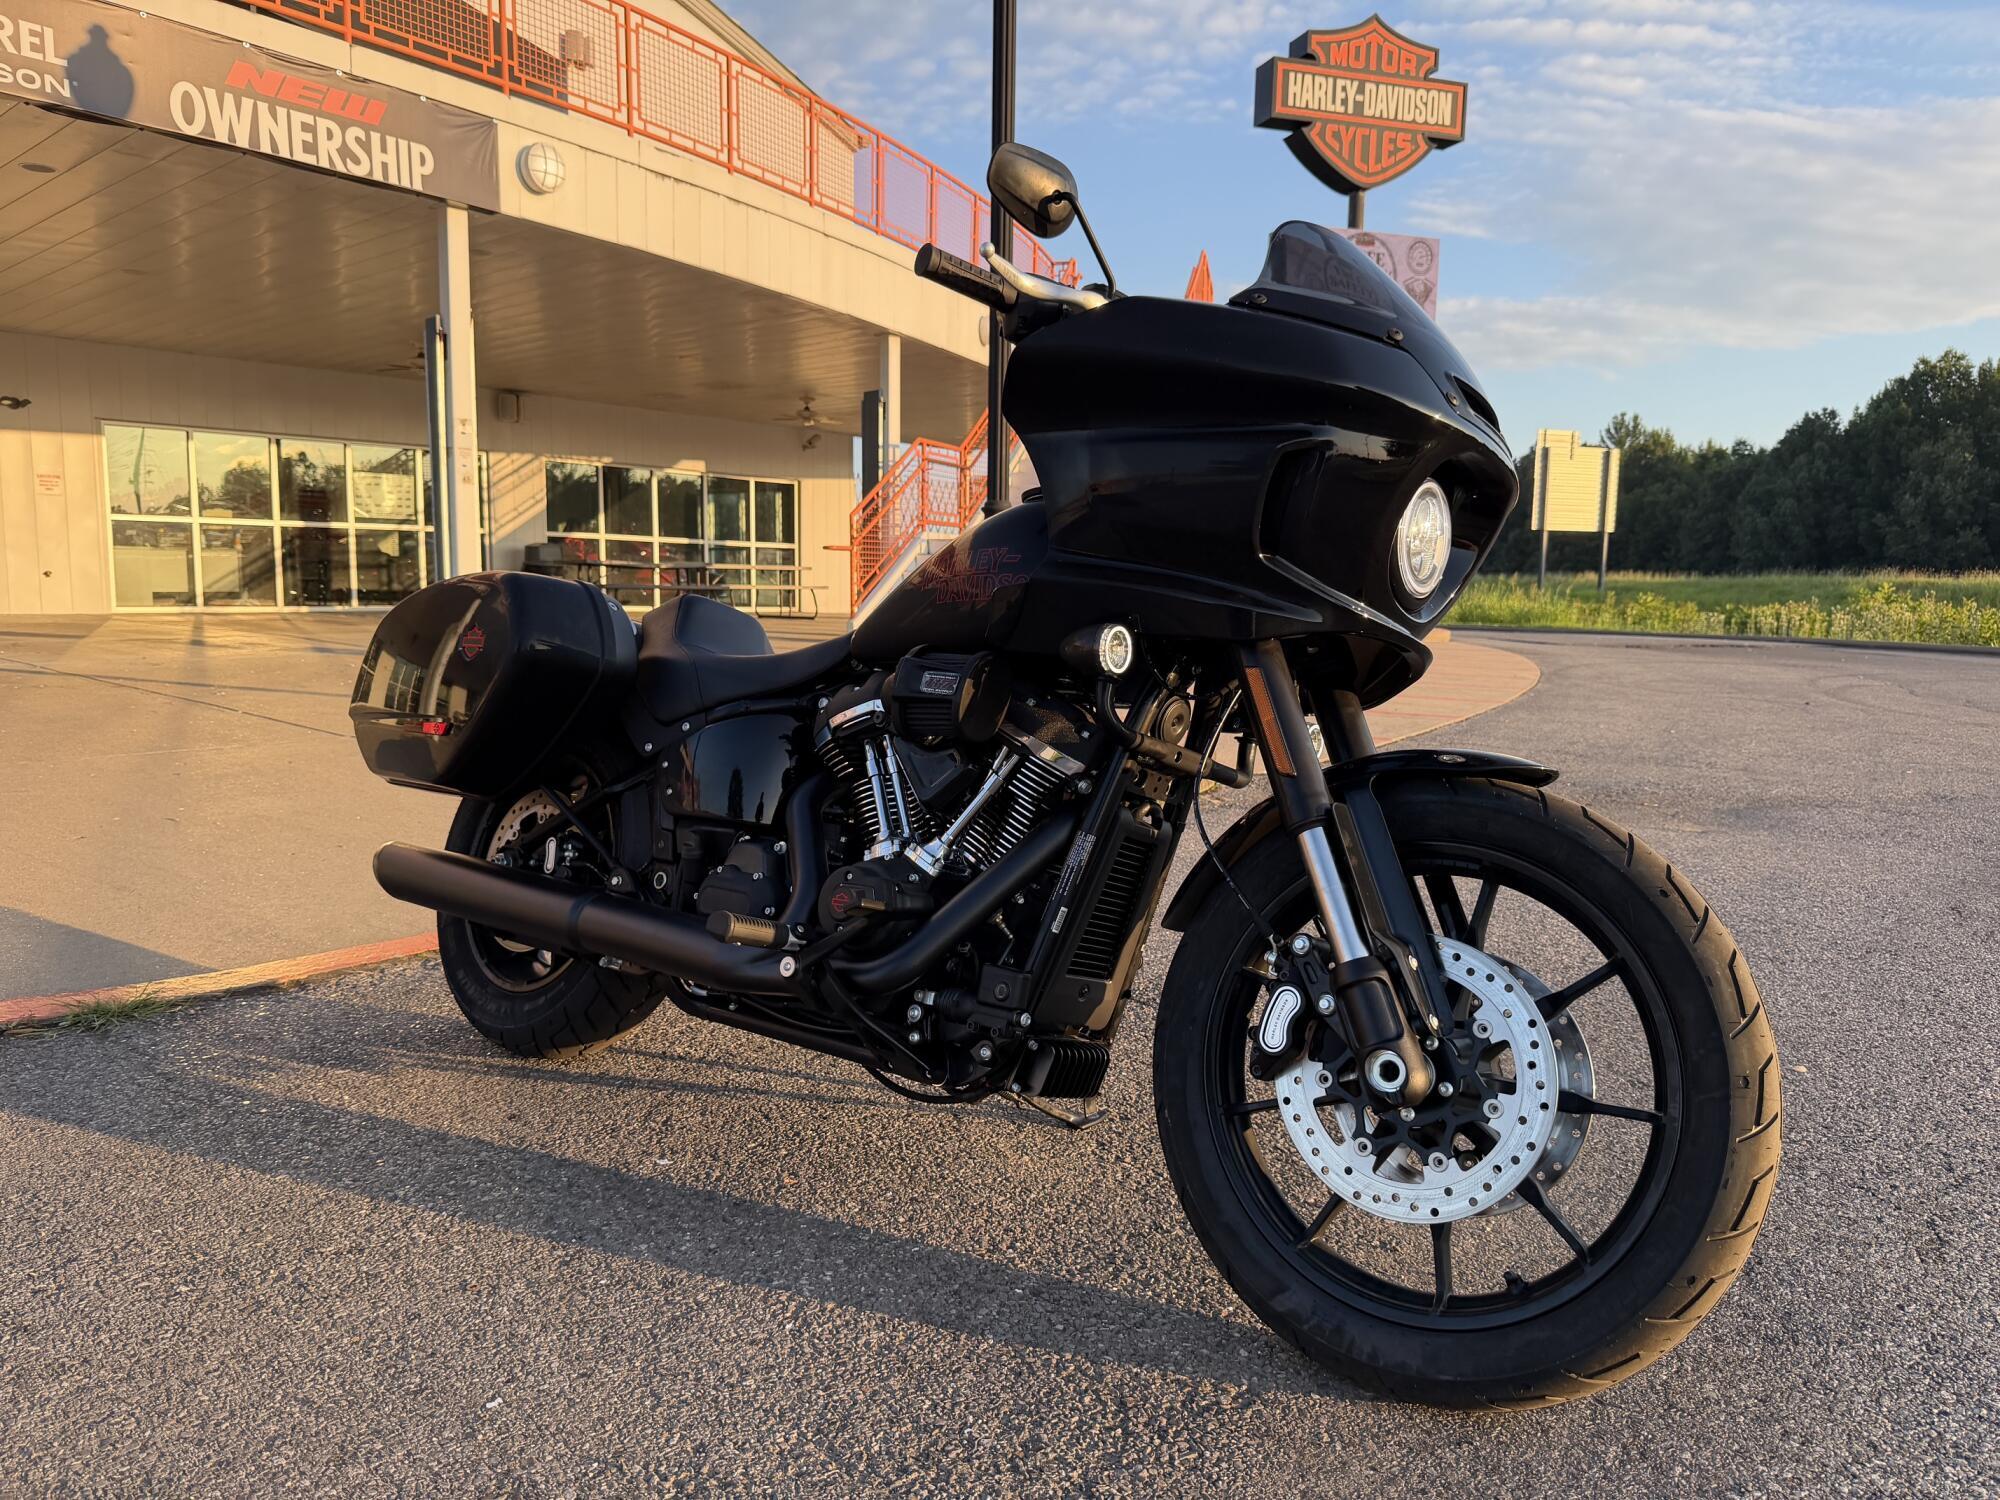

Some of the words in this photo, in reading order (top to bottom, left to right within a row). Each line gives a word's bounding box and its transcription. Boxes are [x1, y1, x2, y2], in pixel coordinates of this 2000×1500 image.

[1329, 33, 1418, 77] MOTOR
[224, 60, 388, 127] NEW
[1287, 71, 1453, 126] HARLEY-DAVIDSON
[169, 80, 435, 191] OWNERSHIP
[1325, 123, 1412, 173] CYCLES
